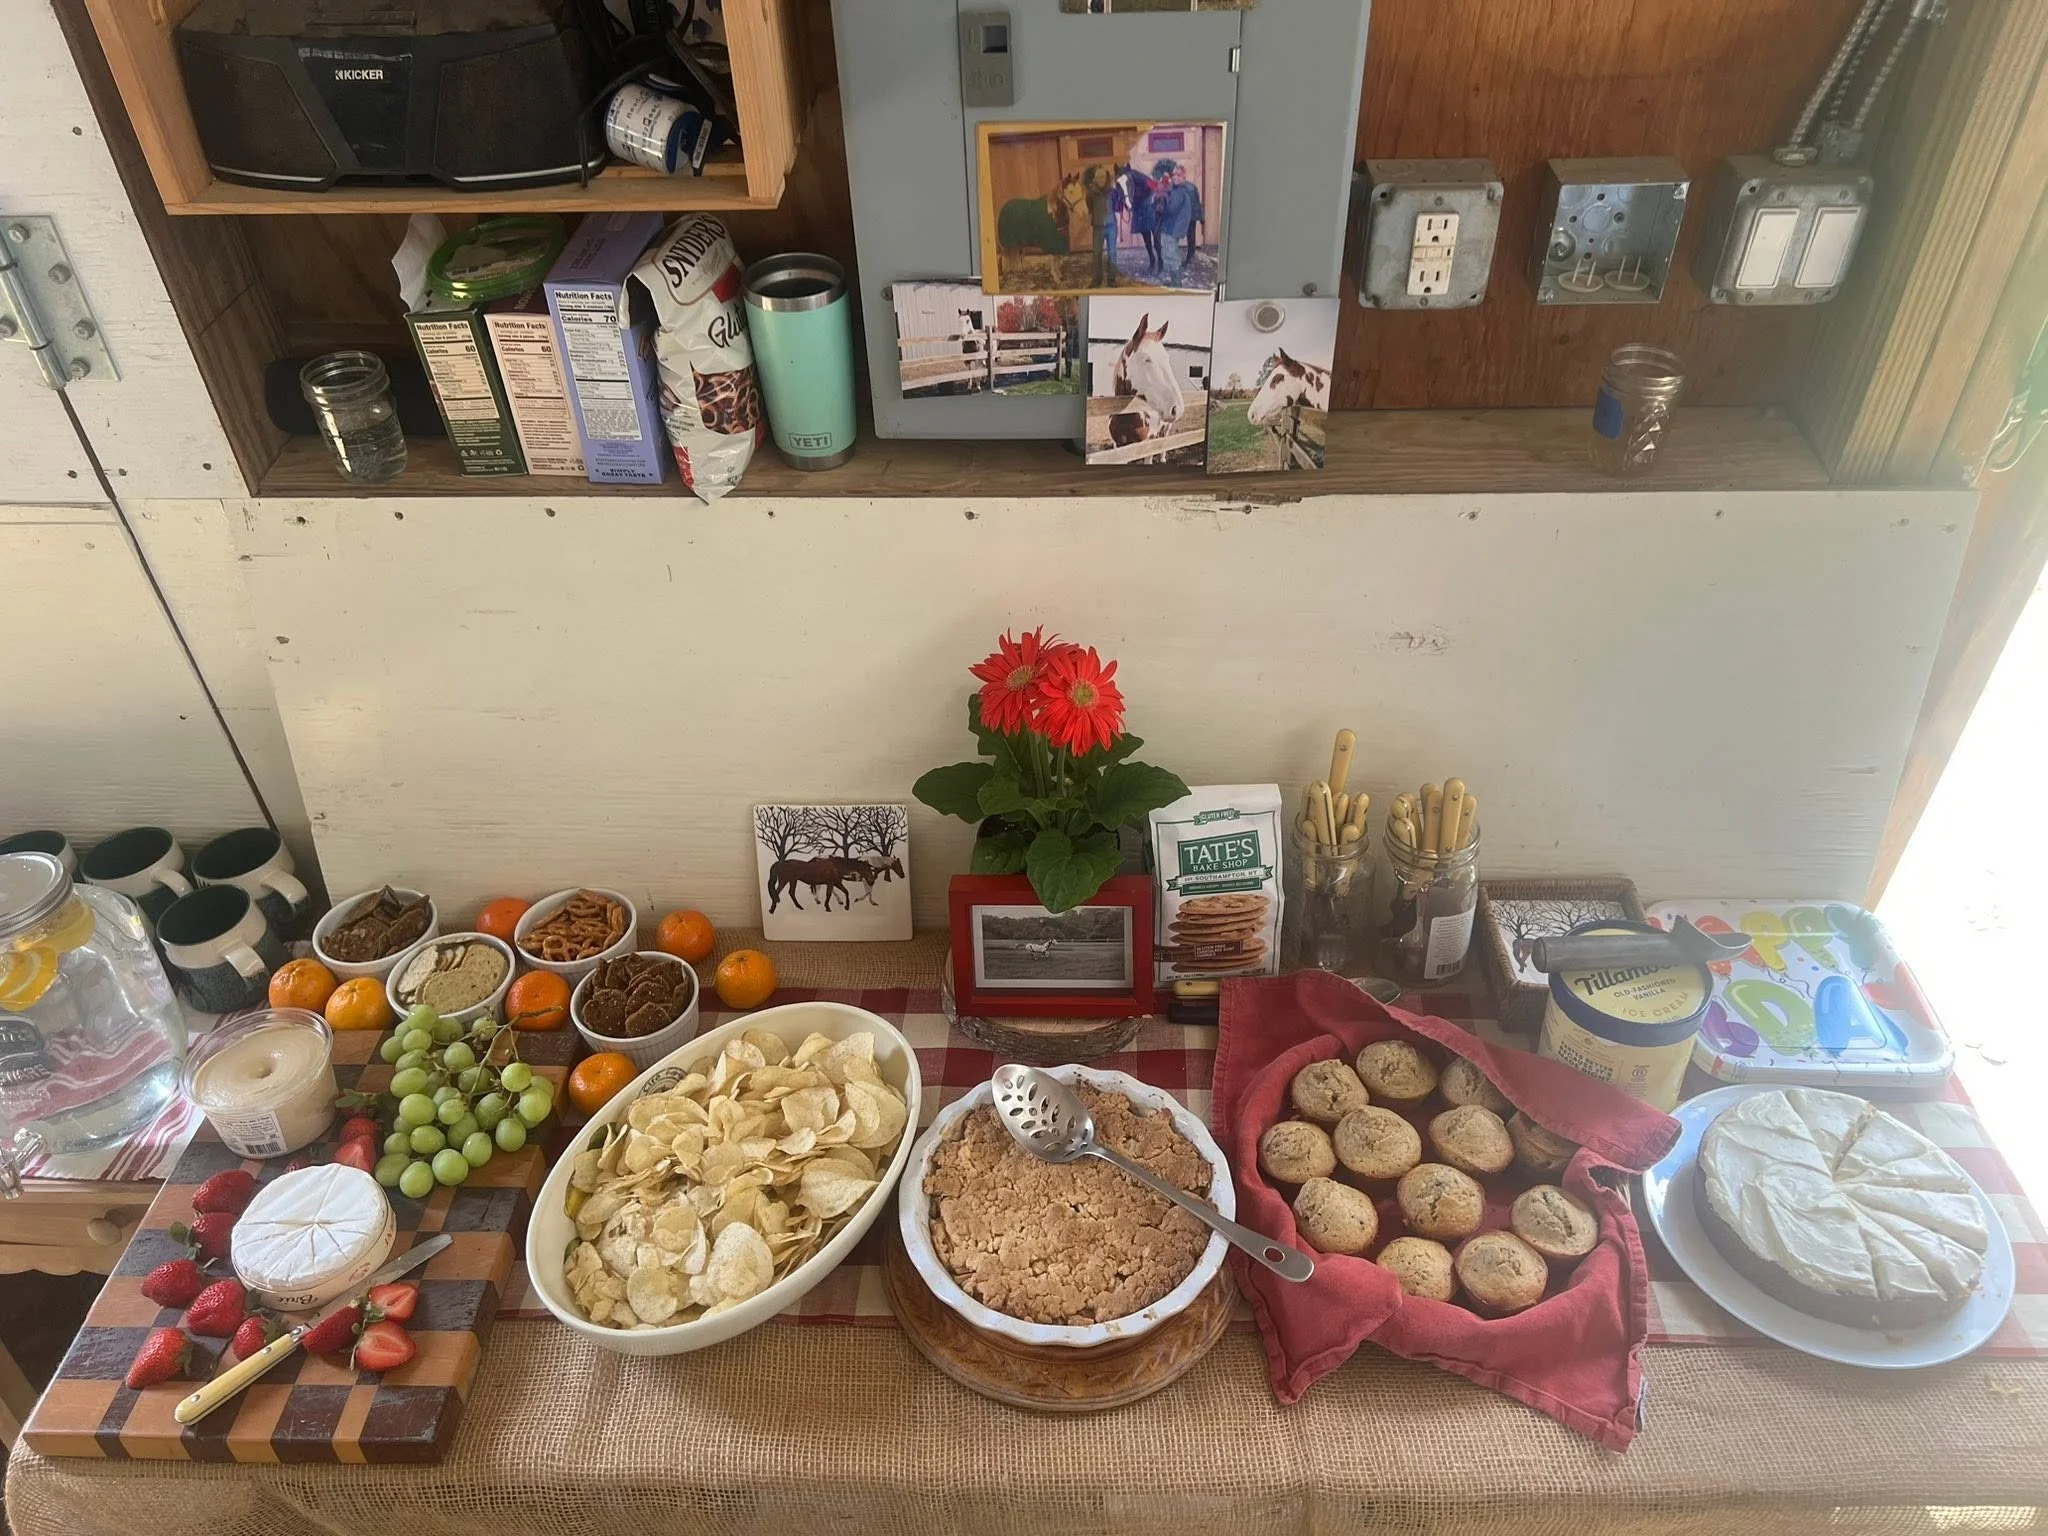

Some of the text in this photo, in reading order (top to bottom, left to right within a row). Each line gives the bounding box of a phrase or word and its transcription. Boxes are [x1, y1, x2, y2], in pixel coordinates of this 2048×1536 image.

[344, 69, 384, 80] KICKER
[555, 291, 613, 300] Nutrition Facts
[603, 315, 616, 323] 70
[465, 345, 476, 353] 60
[541, 345, 552, 353] 60
[792, 436, 829, 448] YETI
[1184, 838, 1254, 865] TATE'S
[1193, 859, 1248, 872] BAKE SHOP
[1195, 872, 1246, 881] SOUTHAMPTON
[1613, 978, 1677, 998] OLD-FASHIONED
[1633, 988, 1666, 1001] VANILLA
[1622, 992, 1690, 1018] ICE CREAM
[1585, 1057, 1614, 1073] BETTER
[277, 1294, 319, 1305] Brie
